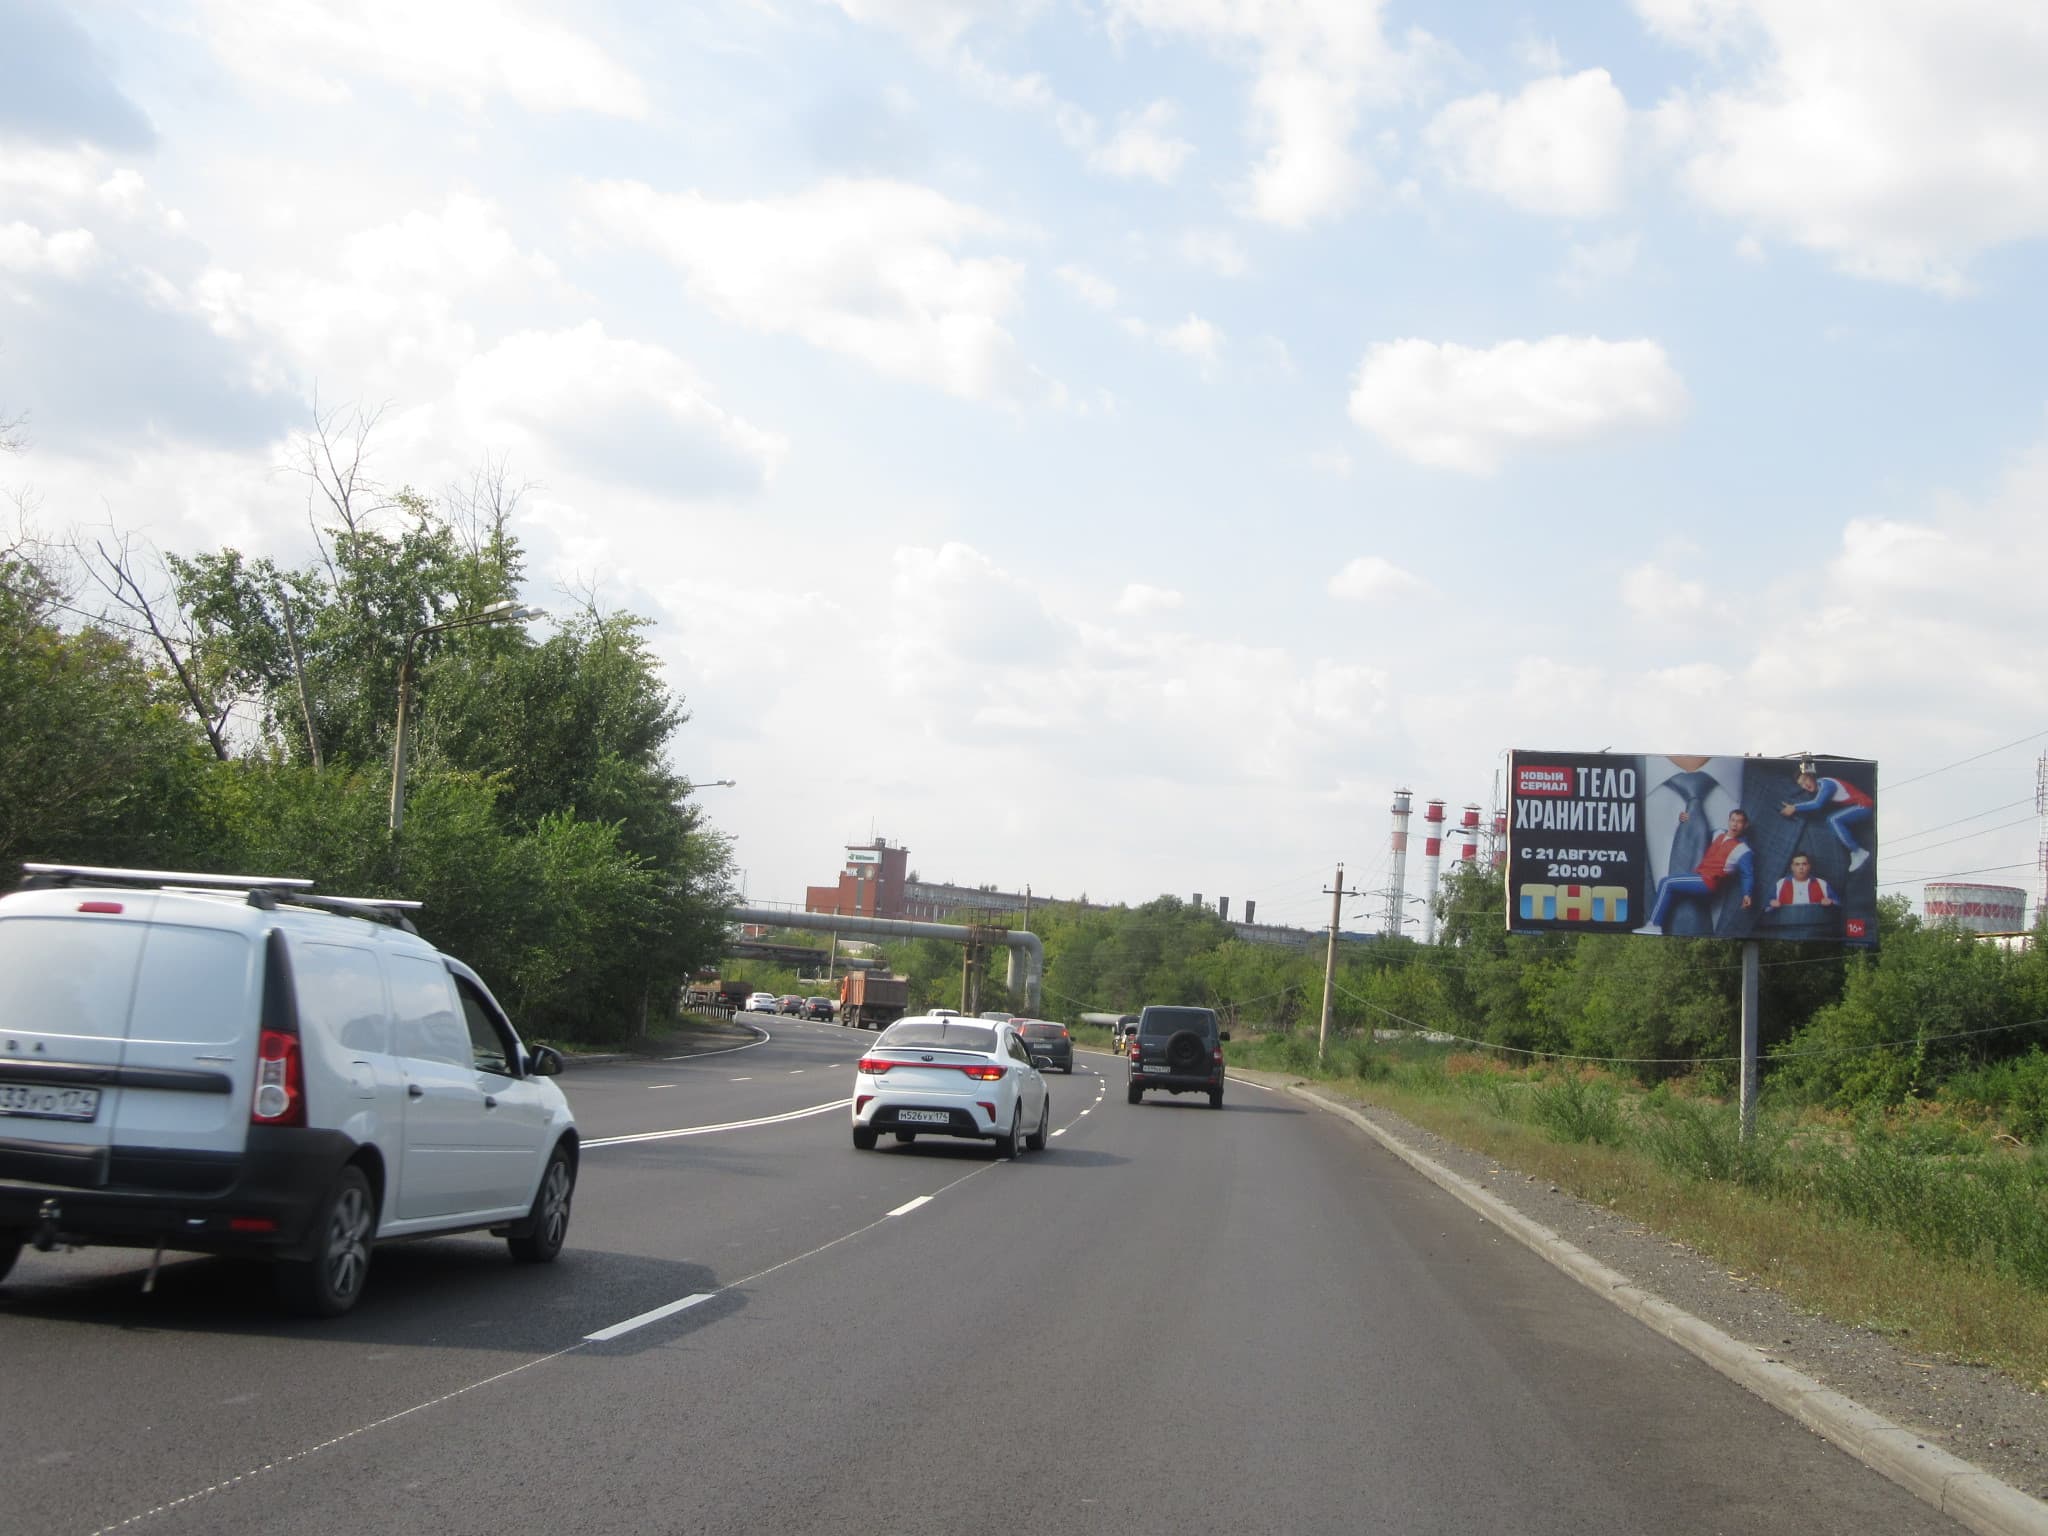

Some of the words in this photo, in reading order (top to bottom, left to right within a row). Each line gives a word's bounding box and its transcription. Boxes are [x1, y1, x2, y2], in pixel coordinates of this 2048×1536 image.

[1520, 771, 1564, 780] НОВЫЙ
[1576, 767, 1636, 799] ТЕЛО
[1520, 781, 1568, 791] СЕРИАЛ
[1516, 800, 1635, 832] ХРАНИТЕЛИ
[1521, 847, 1532, 859] С
[1535, 848, 1554, 860] 21
[1557, 849, 1627, 862] АВГУСТА
[1547, 864, 1602, 878] 20:00
[1520, 884, 1628, 922] ТНТ
